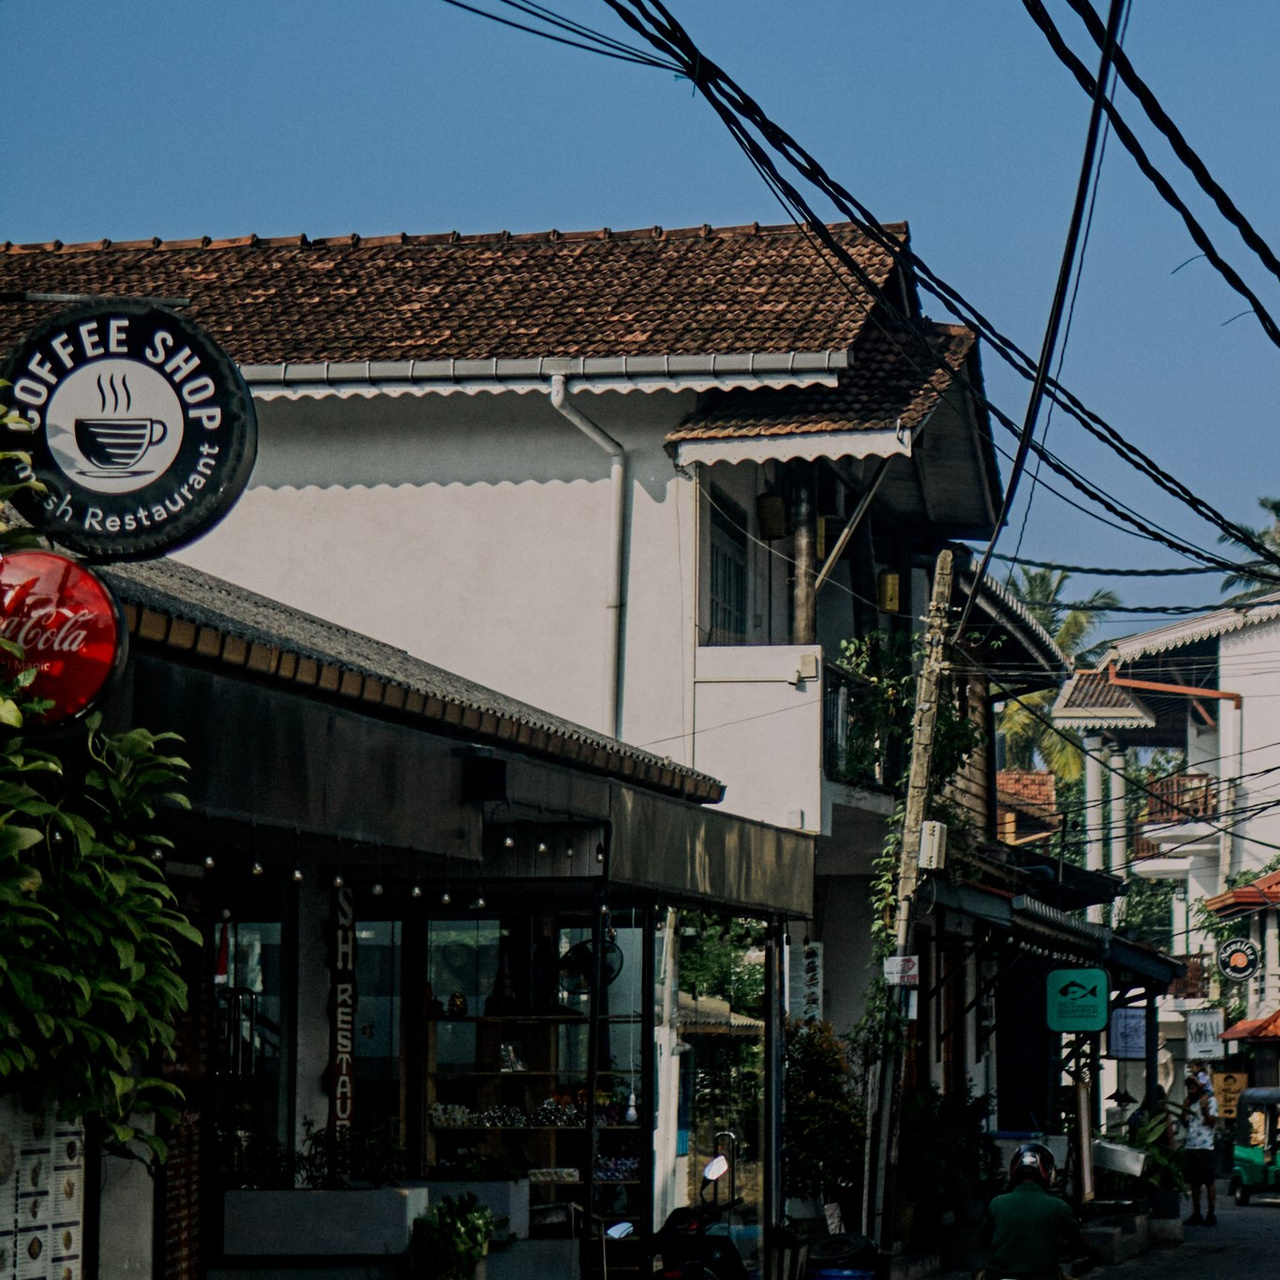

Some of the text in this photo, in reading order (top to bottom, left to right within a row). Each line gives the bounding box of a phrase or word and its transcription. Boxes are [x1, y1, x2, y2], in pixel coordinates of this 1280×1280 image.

[7, 318, 222, 432] COFFEE SHOP
[84, 441, 221, 532] Restaurant
